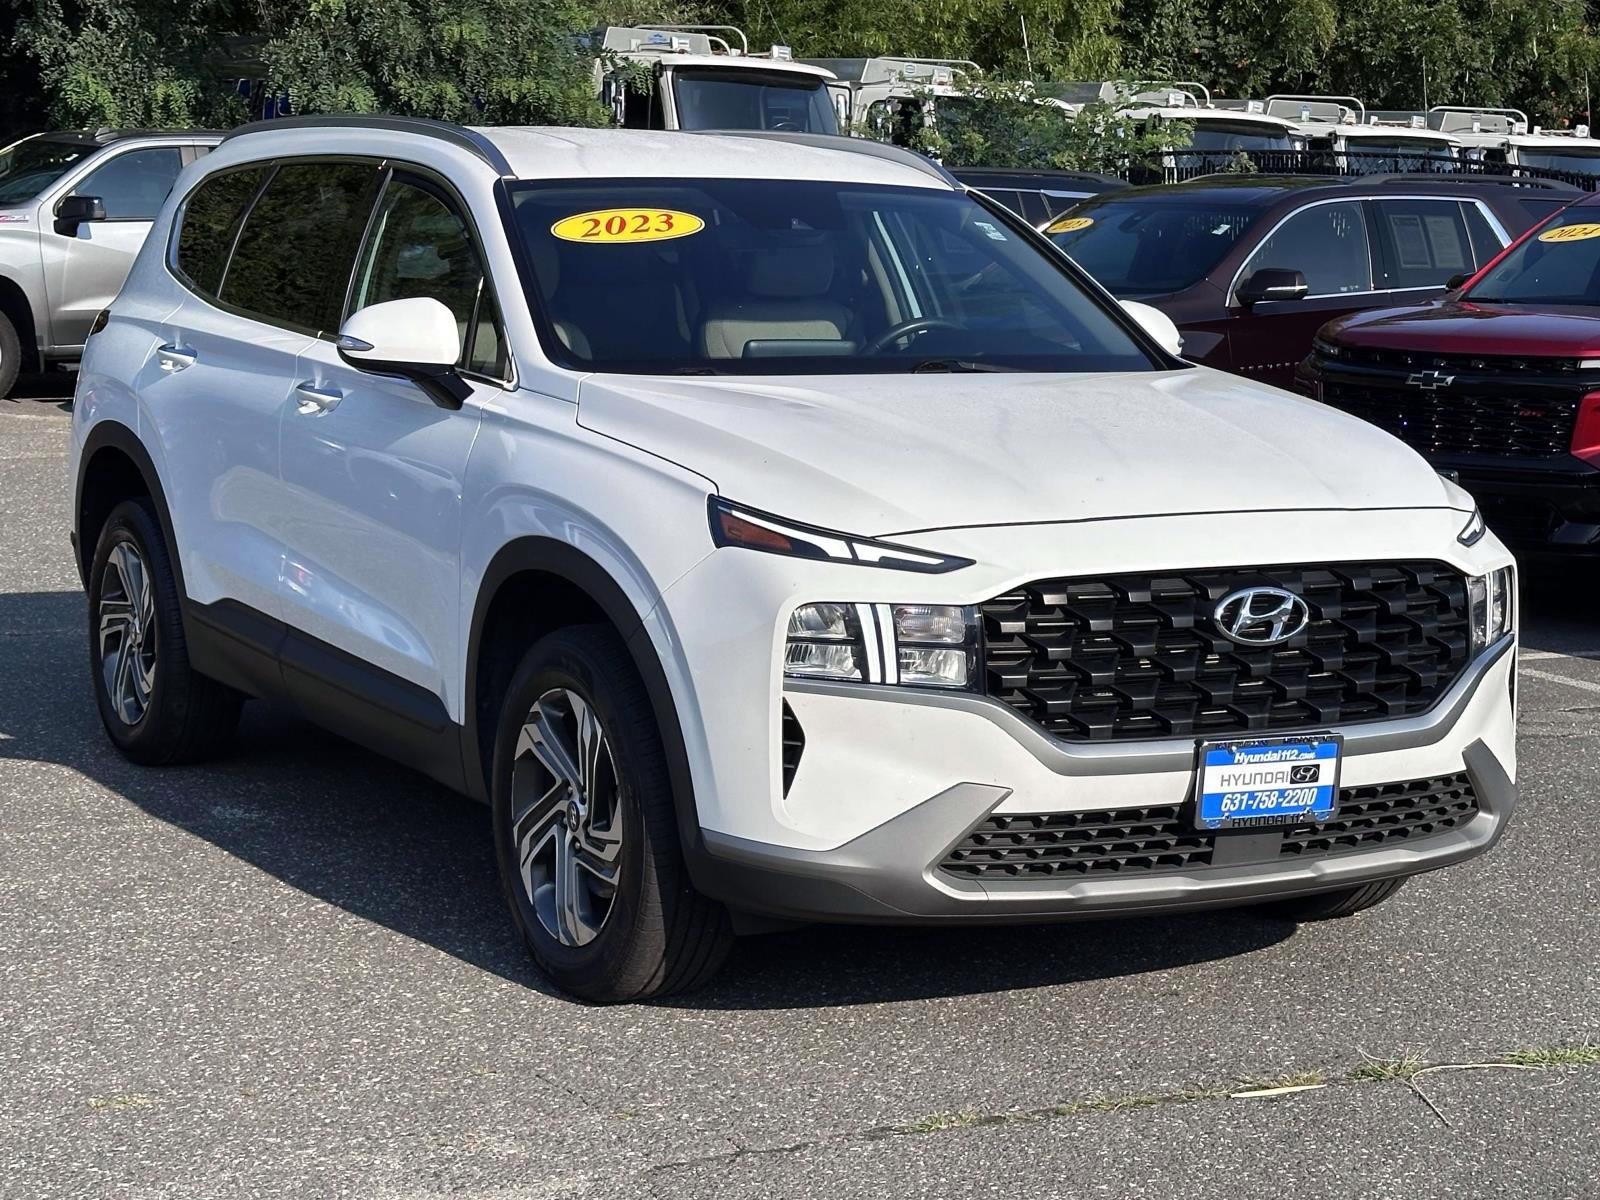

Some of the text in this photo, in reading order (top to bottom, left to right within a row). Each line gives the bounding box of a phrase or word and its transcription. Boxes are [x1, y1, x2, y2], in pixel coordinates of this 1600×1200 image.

[582, 213, 674, 238] 2023
[1221, 770, 1289, 787] HYUNDAI
[1222, 788, 1317, 812] 631-758-2200
[1232, 815, 1287, 827] HYUNDAI
